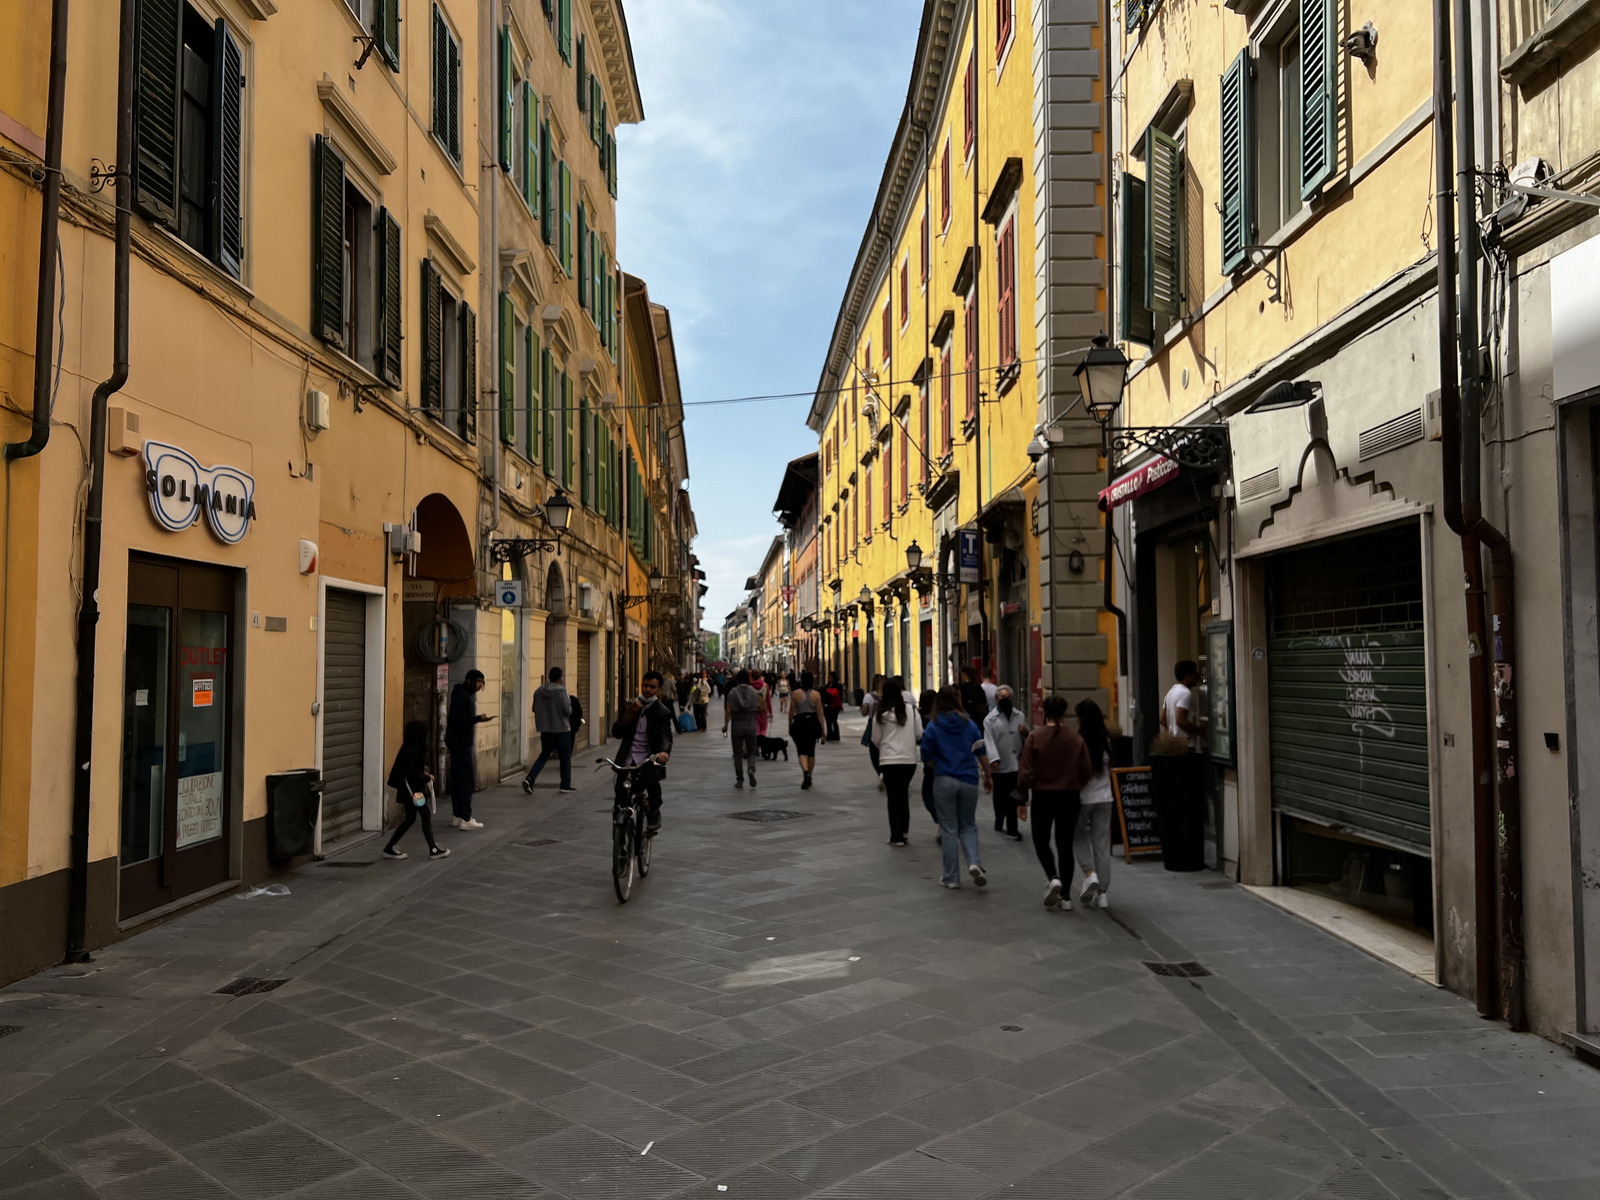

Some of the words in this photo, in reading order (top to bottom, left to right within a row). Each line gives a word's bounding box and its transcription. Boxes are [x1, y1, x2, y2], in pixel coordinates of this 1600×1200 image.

[146, 469, 257, 521] SOLMANIA
[965, 534, 977, 554] T
[180, 646, 227, 666] OUTLET
